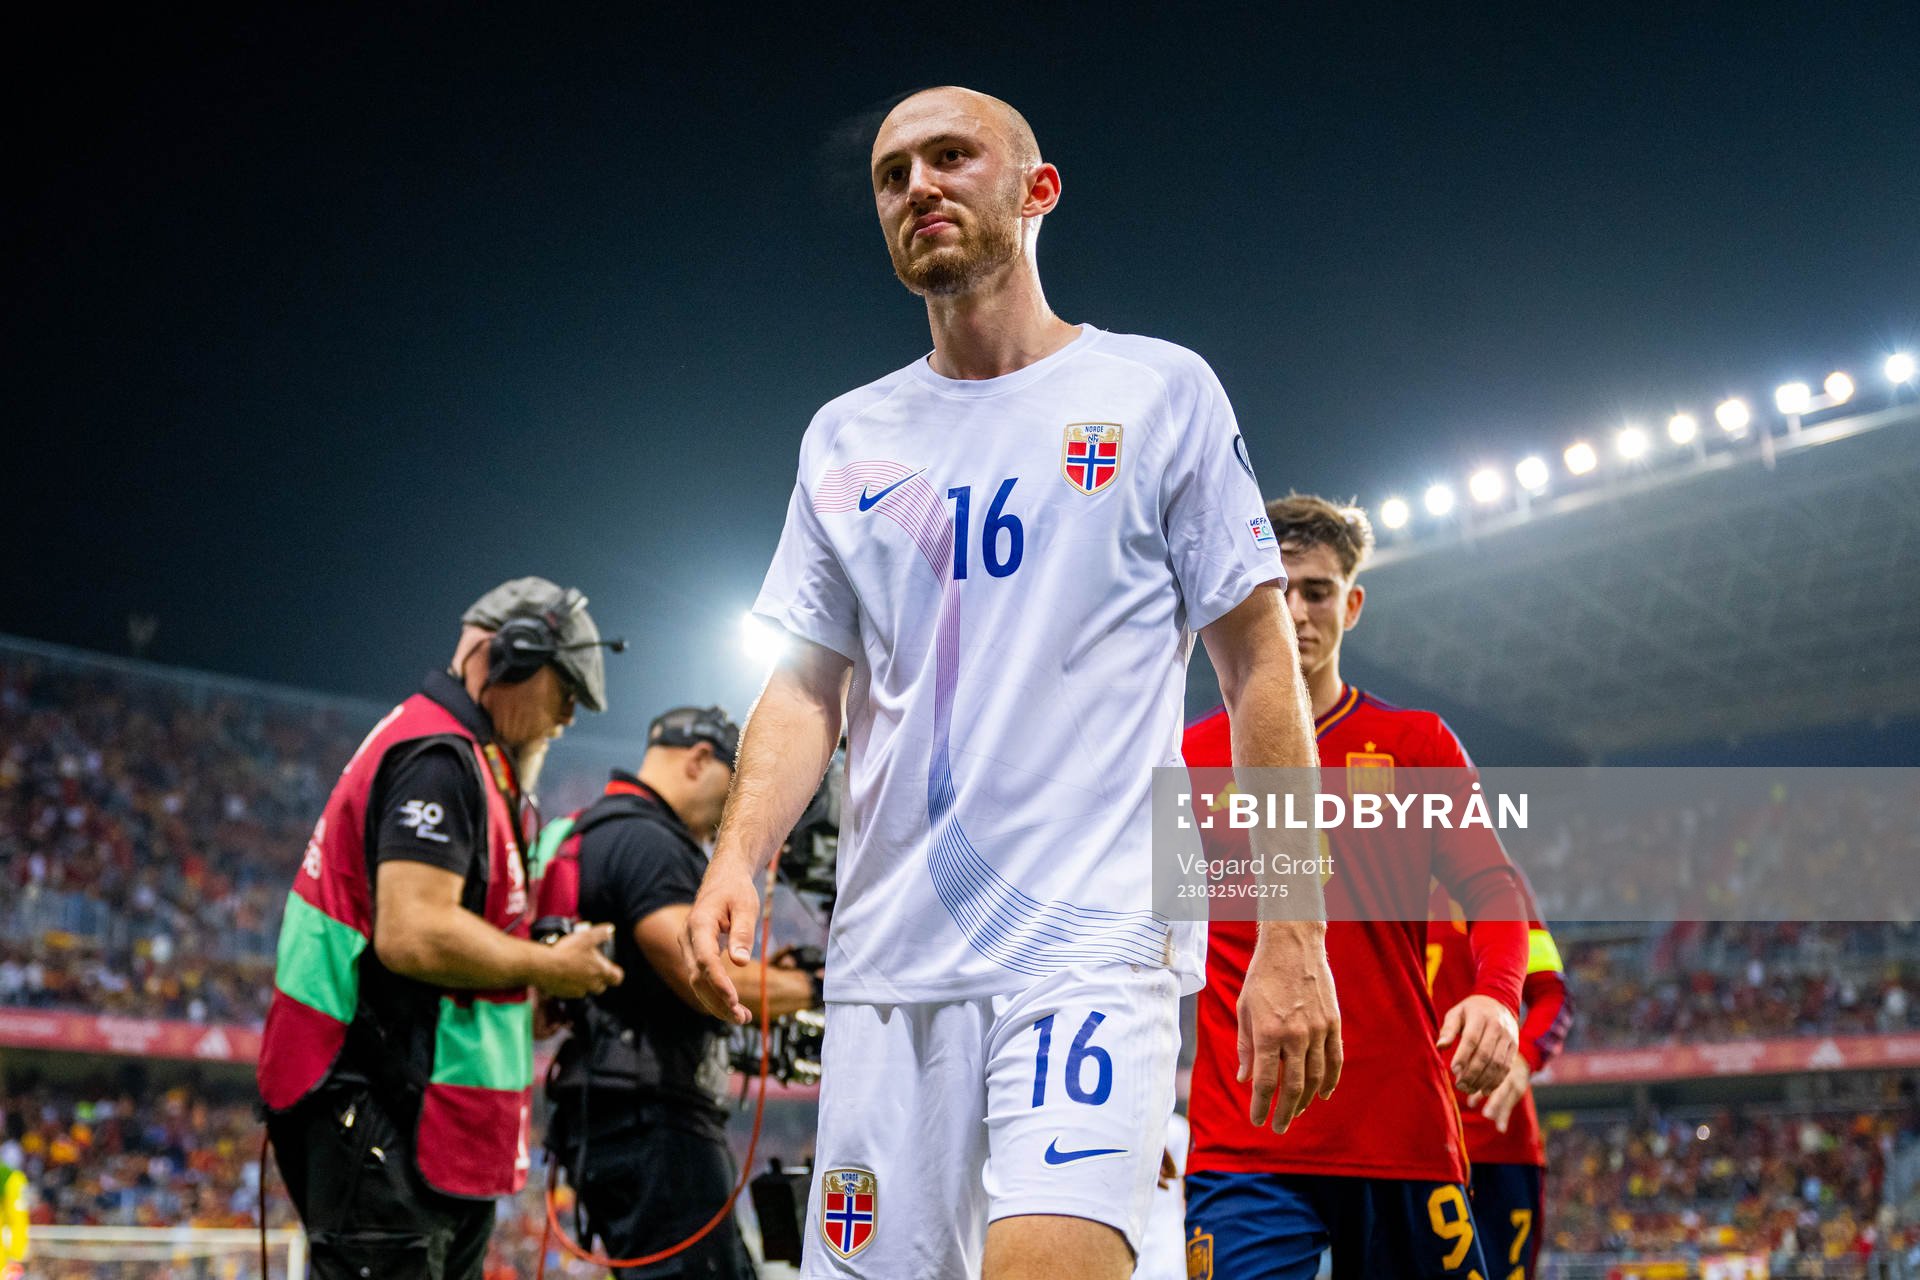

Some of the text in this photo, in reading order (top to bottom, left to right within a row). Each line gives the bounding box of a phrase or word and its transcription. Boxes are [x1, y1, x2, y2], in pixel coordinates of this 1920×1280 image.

[1084, 425, 1104, 433] NORGE
[948, 477, 1023, 580] 16
[1032, 1011, 1112, 1108] 16
[1427, 1184, 1474, 1270] 9
[1509, 1209, 1532, 1264] 7
